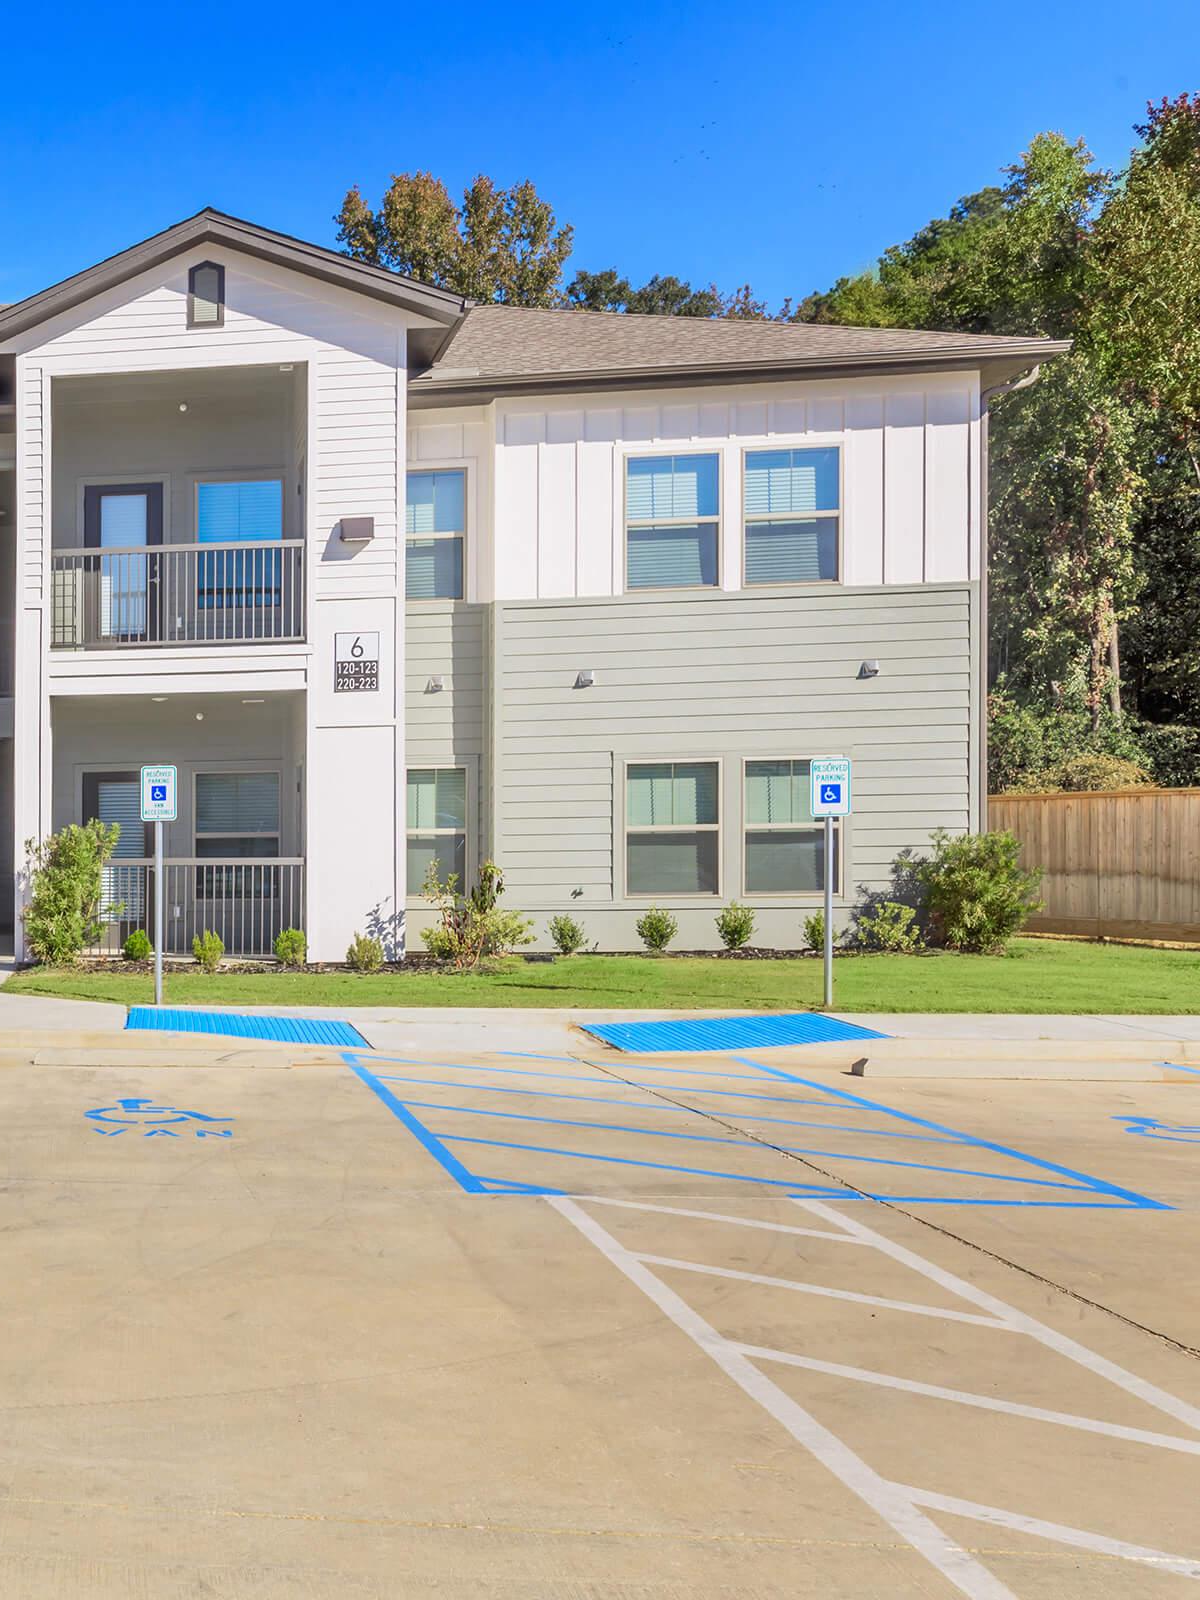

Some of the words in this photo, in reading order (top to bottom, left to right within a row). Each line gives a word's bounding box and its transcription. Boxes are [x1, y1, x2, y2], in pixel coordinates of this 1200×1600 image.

[351, 636, 364, 658] 6
[337, 662, 377, 674] 120-123
[337, 677, 377, 690] 220-223
[813, 764, 848, 772] RESERVED
[91, 1127, 234, 1138] VAN
